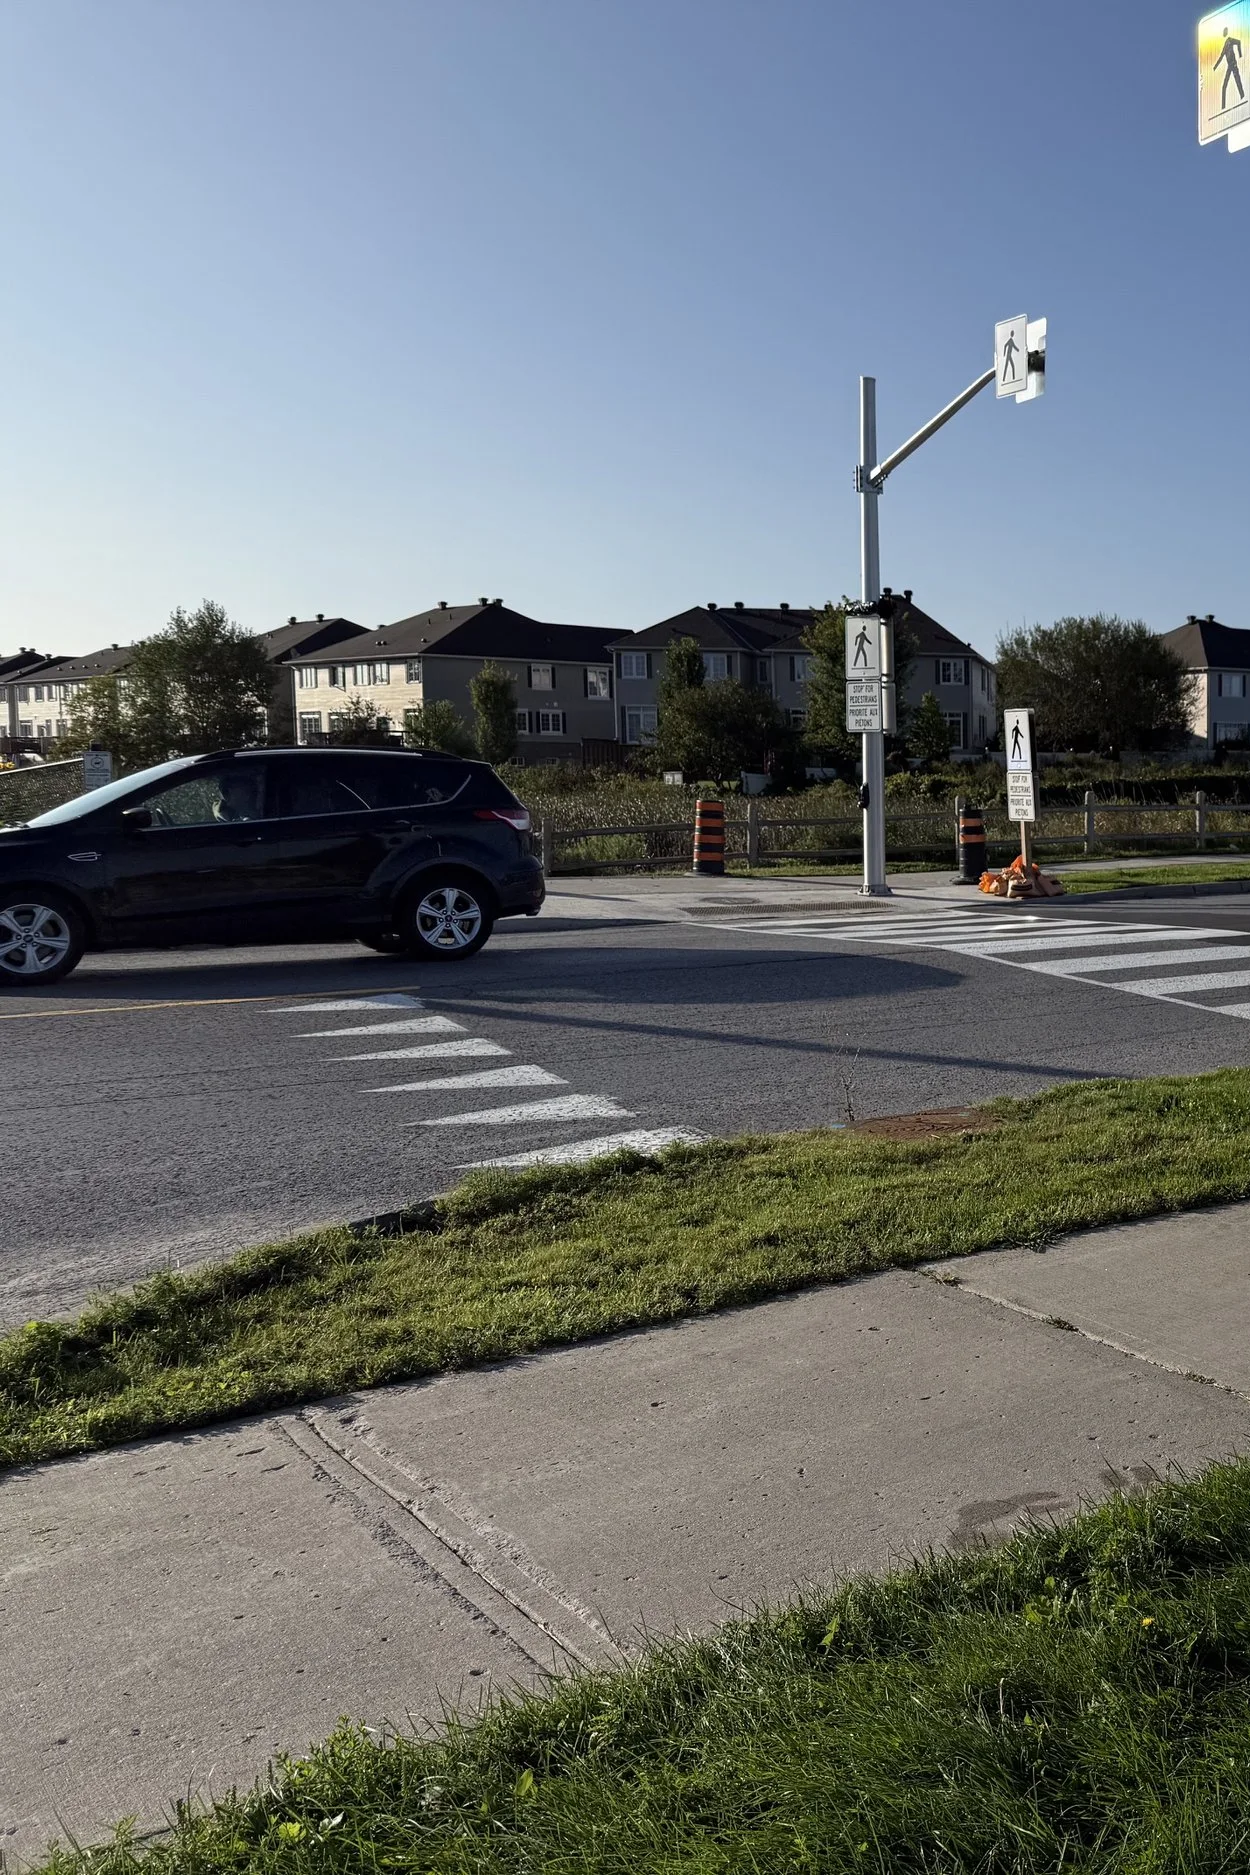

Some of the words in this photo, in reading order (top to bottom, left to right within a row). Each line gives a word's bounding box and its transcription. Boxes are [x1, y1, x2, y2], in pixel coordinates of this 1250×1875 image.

[853, 684, 864, 693] STOP
[865, 684, 874, 692] FOR
[849, 695, 878, 704] PEDESTRIANS
